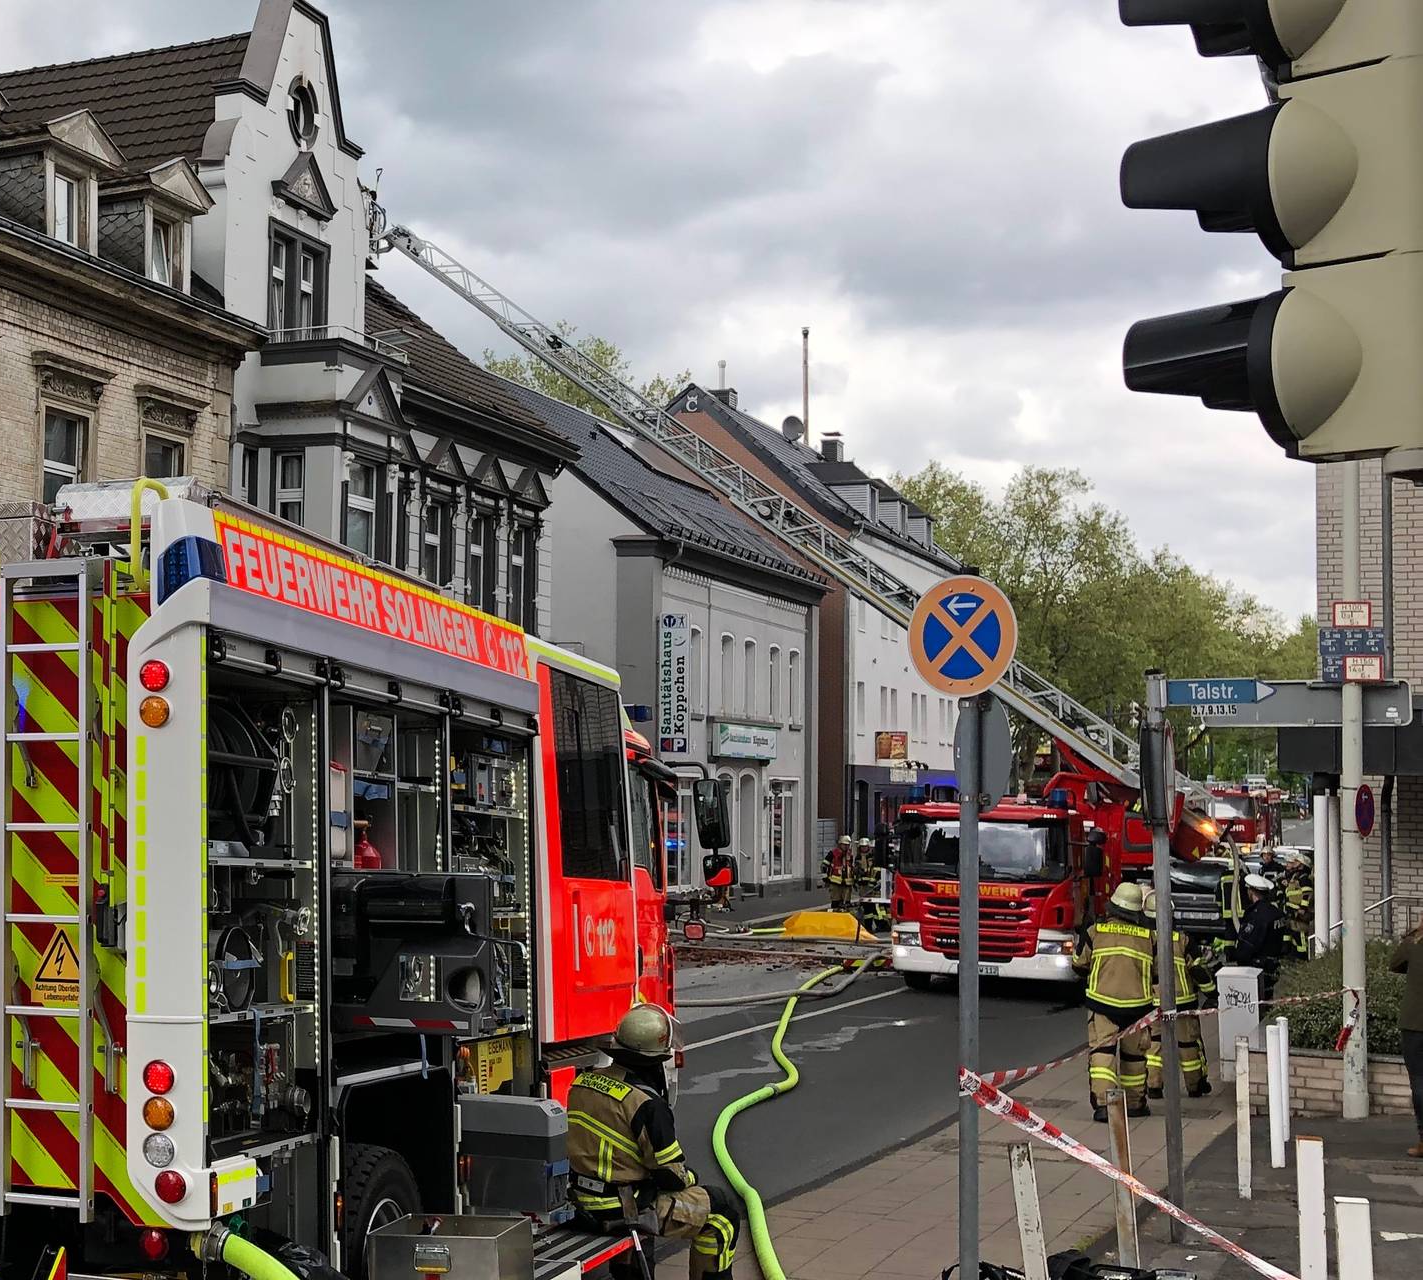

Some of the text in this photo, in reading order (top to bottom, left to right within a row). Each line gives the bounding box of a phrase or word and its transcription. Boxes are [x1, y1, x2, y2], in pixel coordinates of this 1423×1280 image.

[223, 527, 528, 677] FEUERWEHR SOLINGEN 112
[660, 631, 672, 735] Sanitätshaus
[673, 655, 687, 735] Köppchen
[1188, 683, 1238, 700] Talstr.
[938, 884, 1018, 897] FEUWEHR
[597, 918, 617, 957] 112
[35, 983, 57, 993] Achtung
